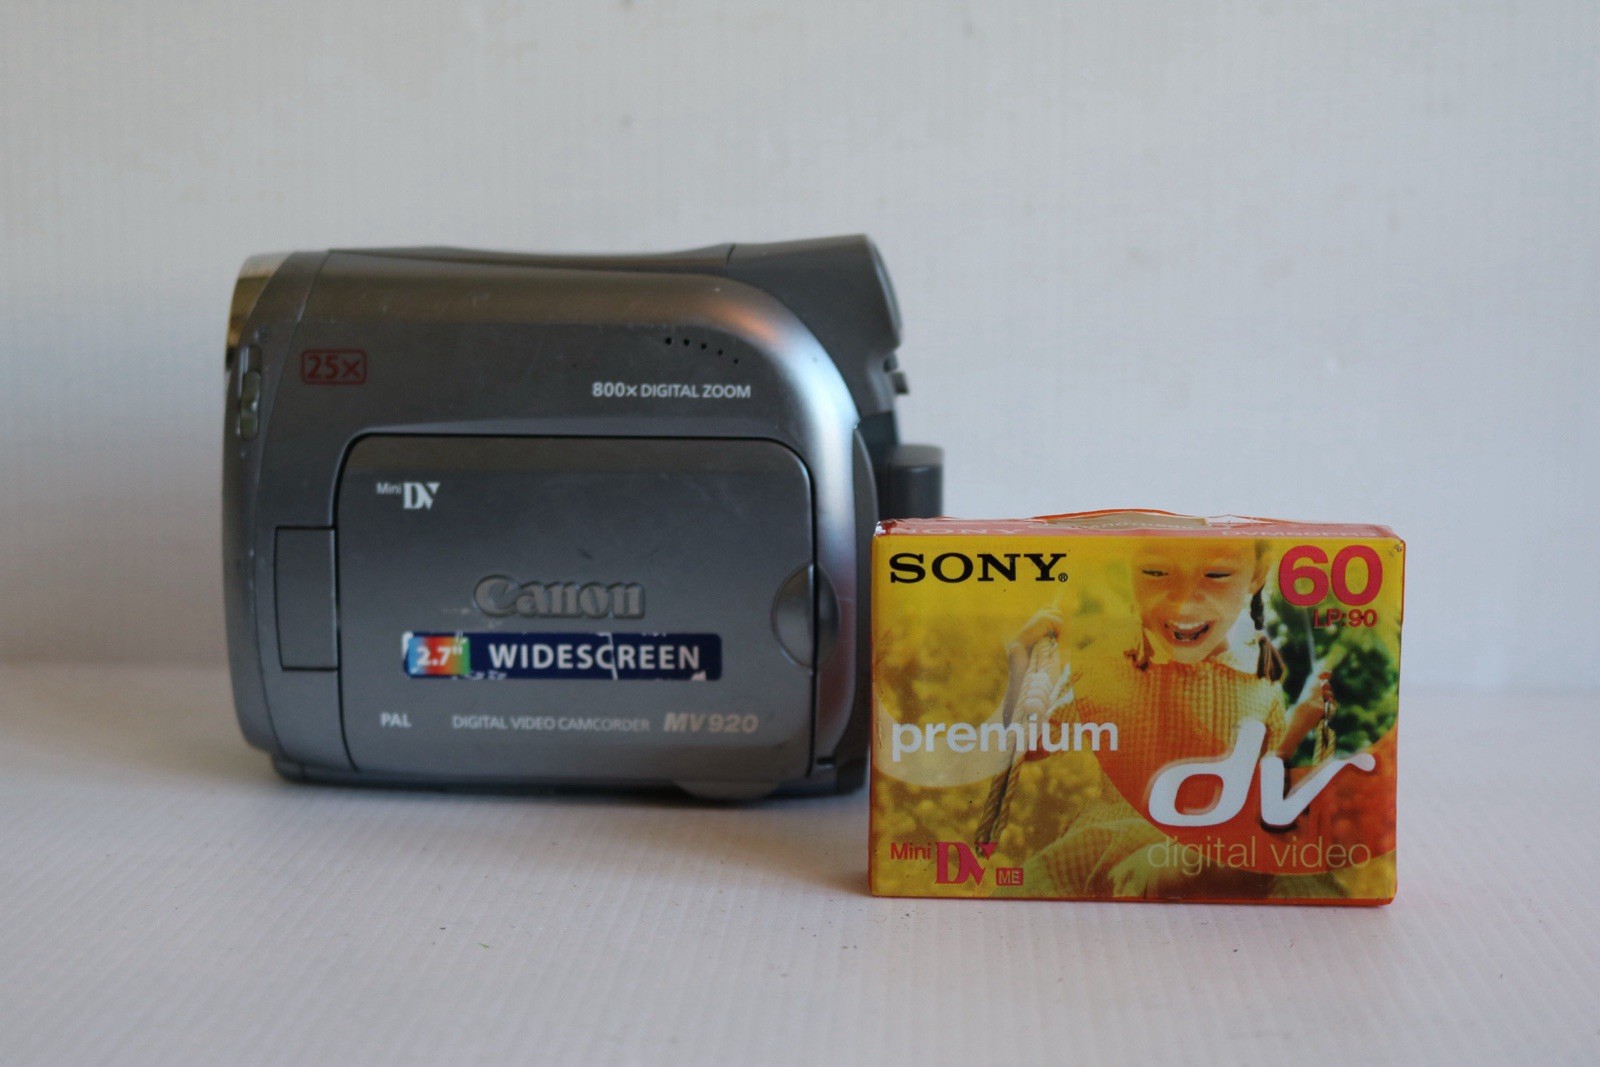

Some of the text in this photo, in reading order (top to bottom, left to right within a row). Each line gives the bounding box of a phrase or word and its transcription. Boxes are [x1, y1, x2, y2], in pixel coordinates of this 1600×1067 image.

[641, 383, 699, 398] DIGITAL
[702, 385, 751, 398] ZOOM
[376, 482, 440, 510] Mini DV
[1278, 544, 1383, 607] 60
[473, 574, 646, 619] Canon
[1313, 608, 1378, 628] LP:90
[488, 643, 700, 670] WIDESCREEN
[380, 713, 412, 729] PAL
[452, 714, 507, 730] DIGITAL
[509, 715, 555, 731] VIDEO
[558, 716, 650, 732] CAMCORDER
[891, 713, 1119, 762] premium
[1148, 718, 1376, 827] dv
[890, 841, 1020, 886] Mini DV ME
[1147, 836, 1371, 875] digital video
